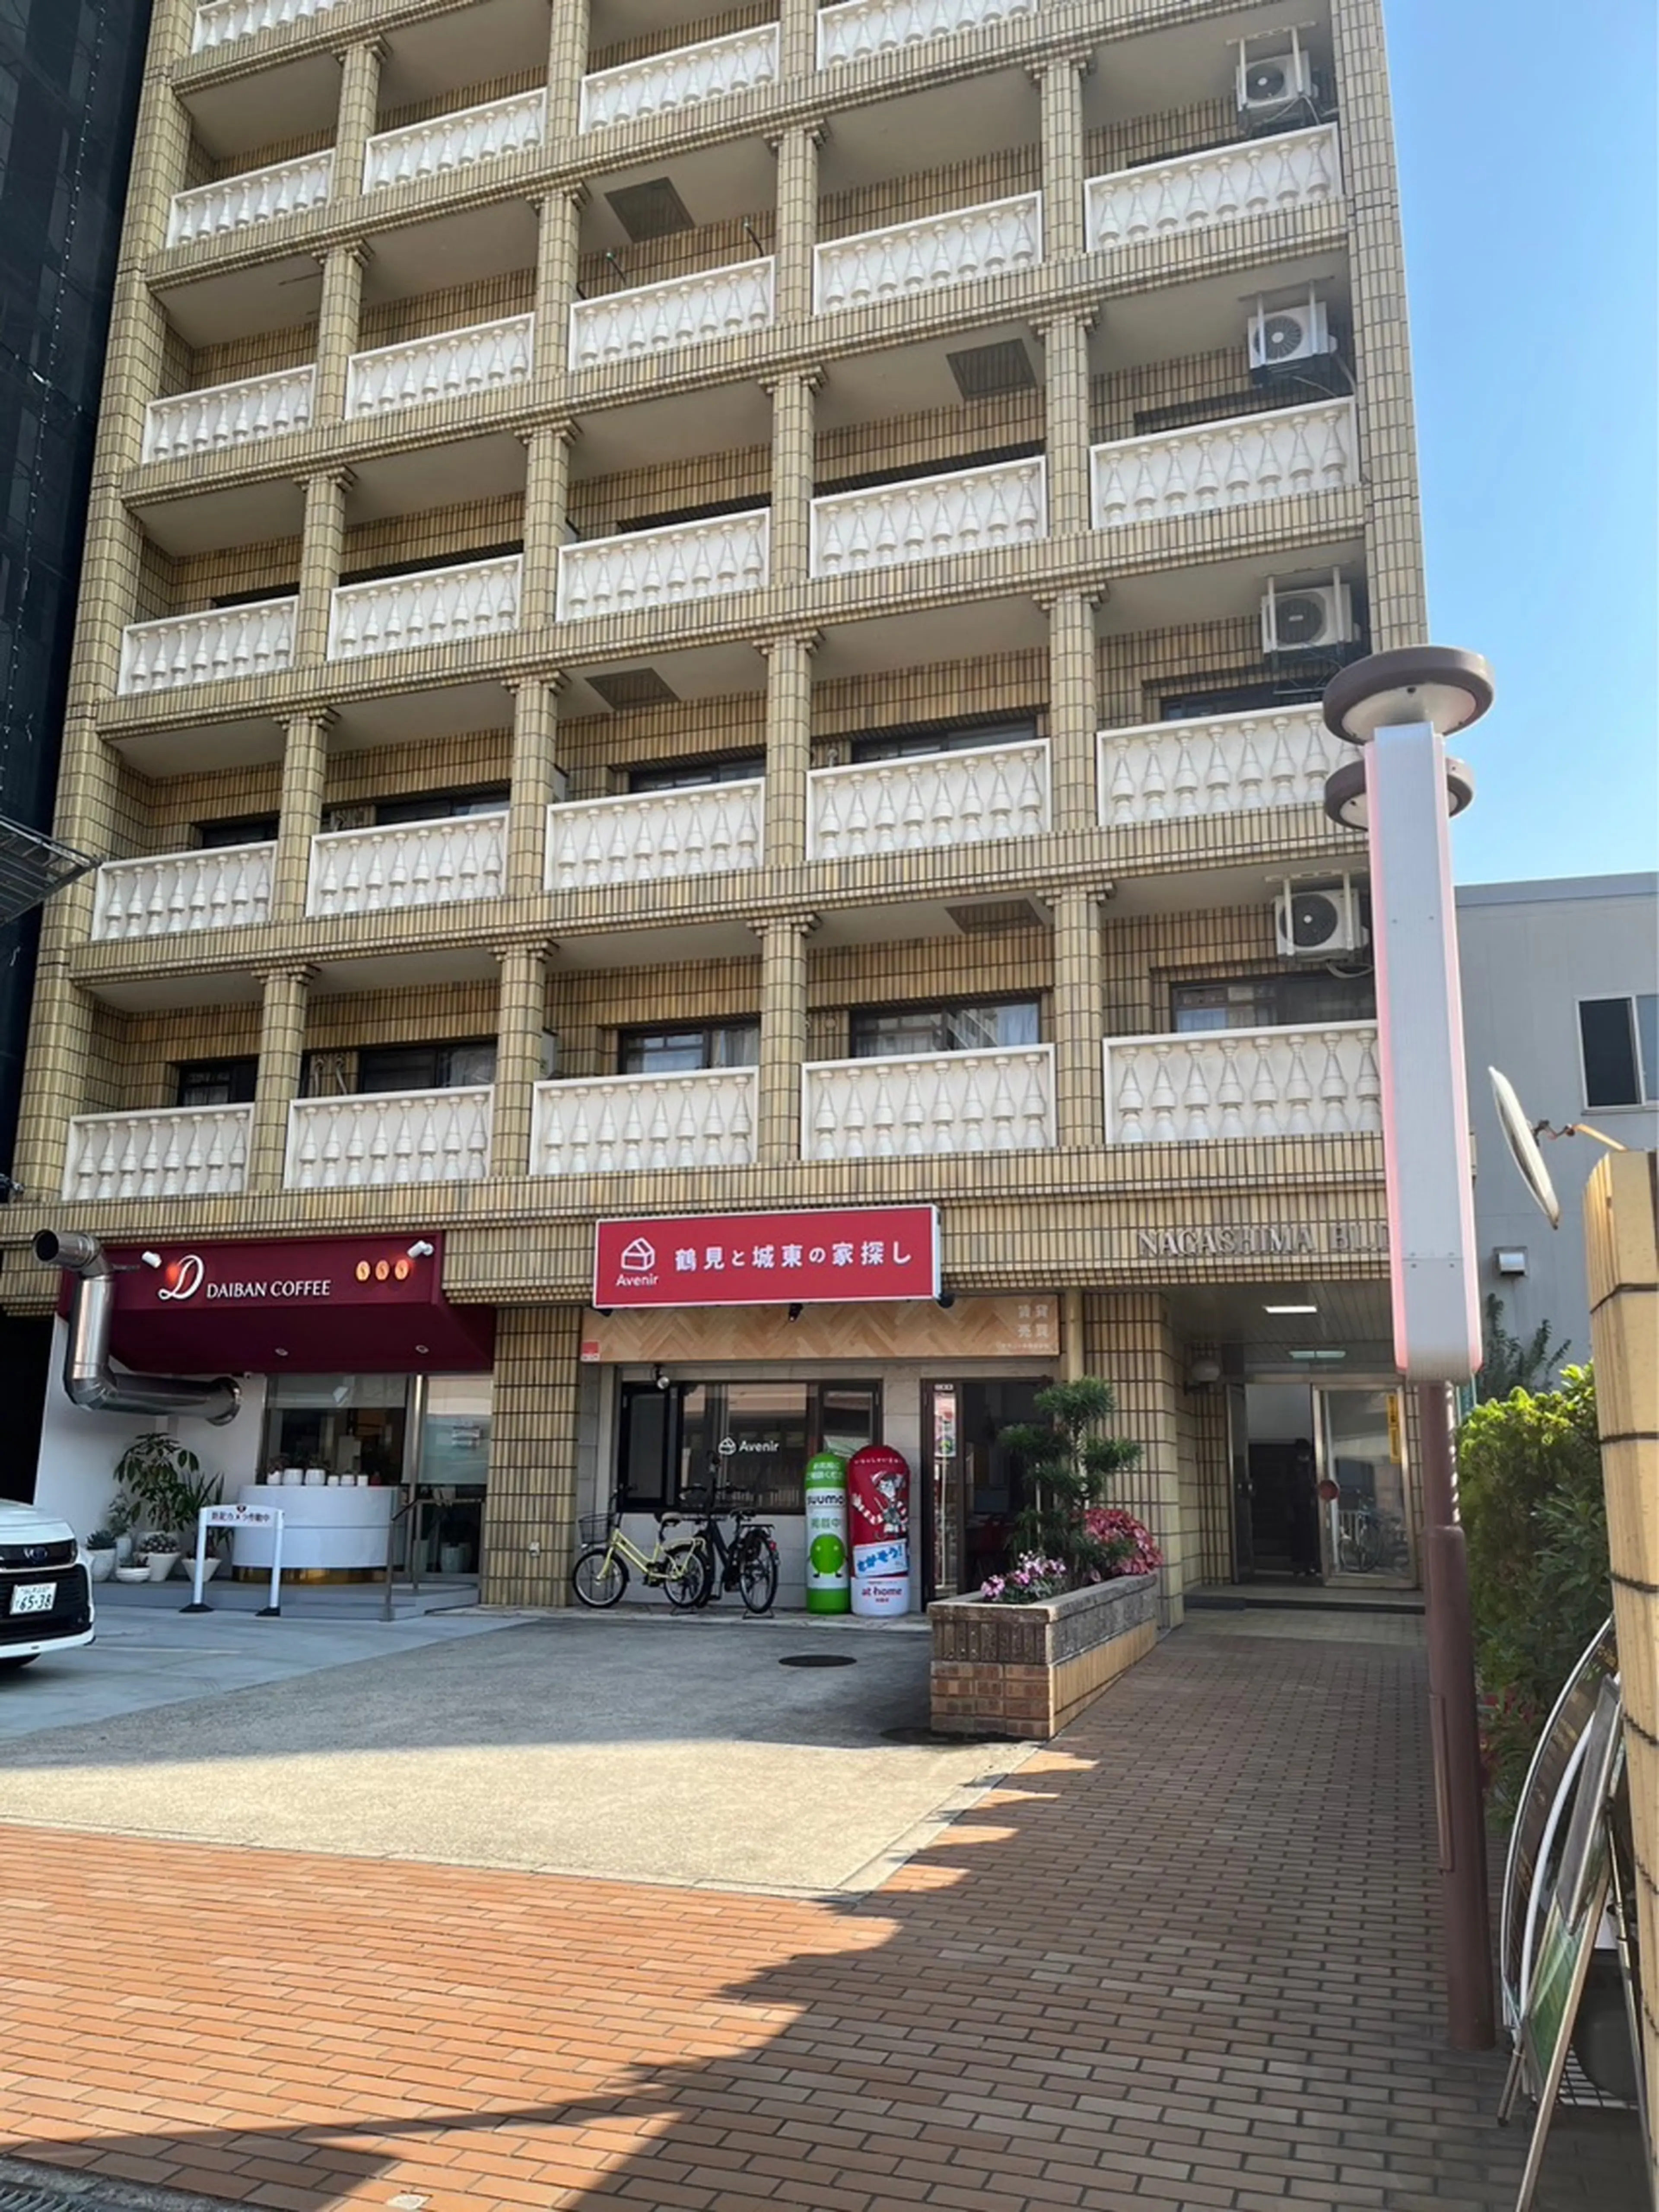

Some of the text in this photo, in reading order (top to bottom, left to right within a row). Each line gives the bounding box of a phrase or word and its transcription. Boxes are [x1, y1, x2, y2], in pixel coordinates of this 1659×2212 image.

[1138, 1225, 1316, 1256] NAGASHIMA
[675, 1241, 912, 1271] 鶴見と城東の家探し
[615, 1273, 660, 1287] Avenir
[206, 1282, 267, 1299] DAIBAN
[270, 1280, 331, 1297] COFFEE
[738, 1440, 780, 1453] Avenir
[874, 1586, 903, 1596] home
